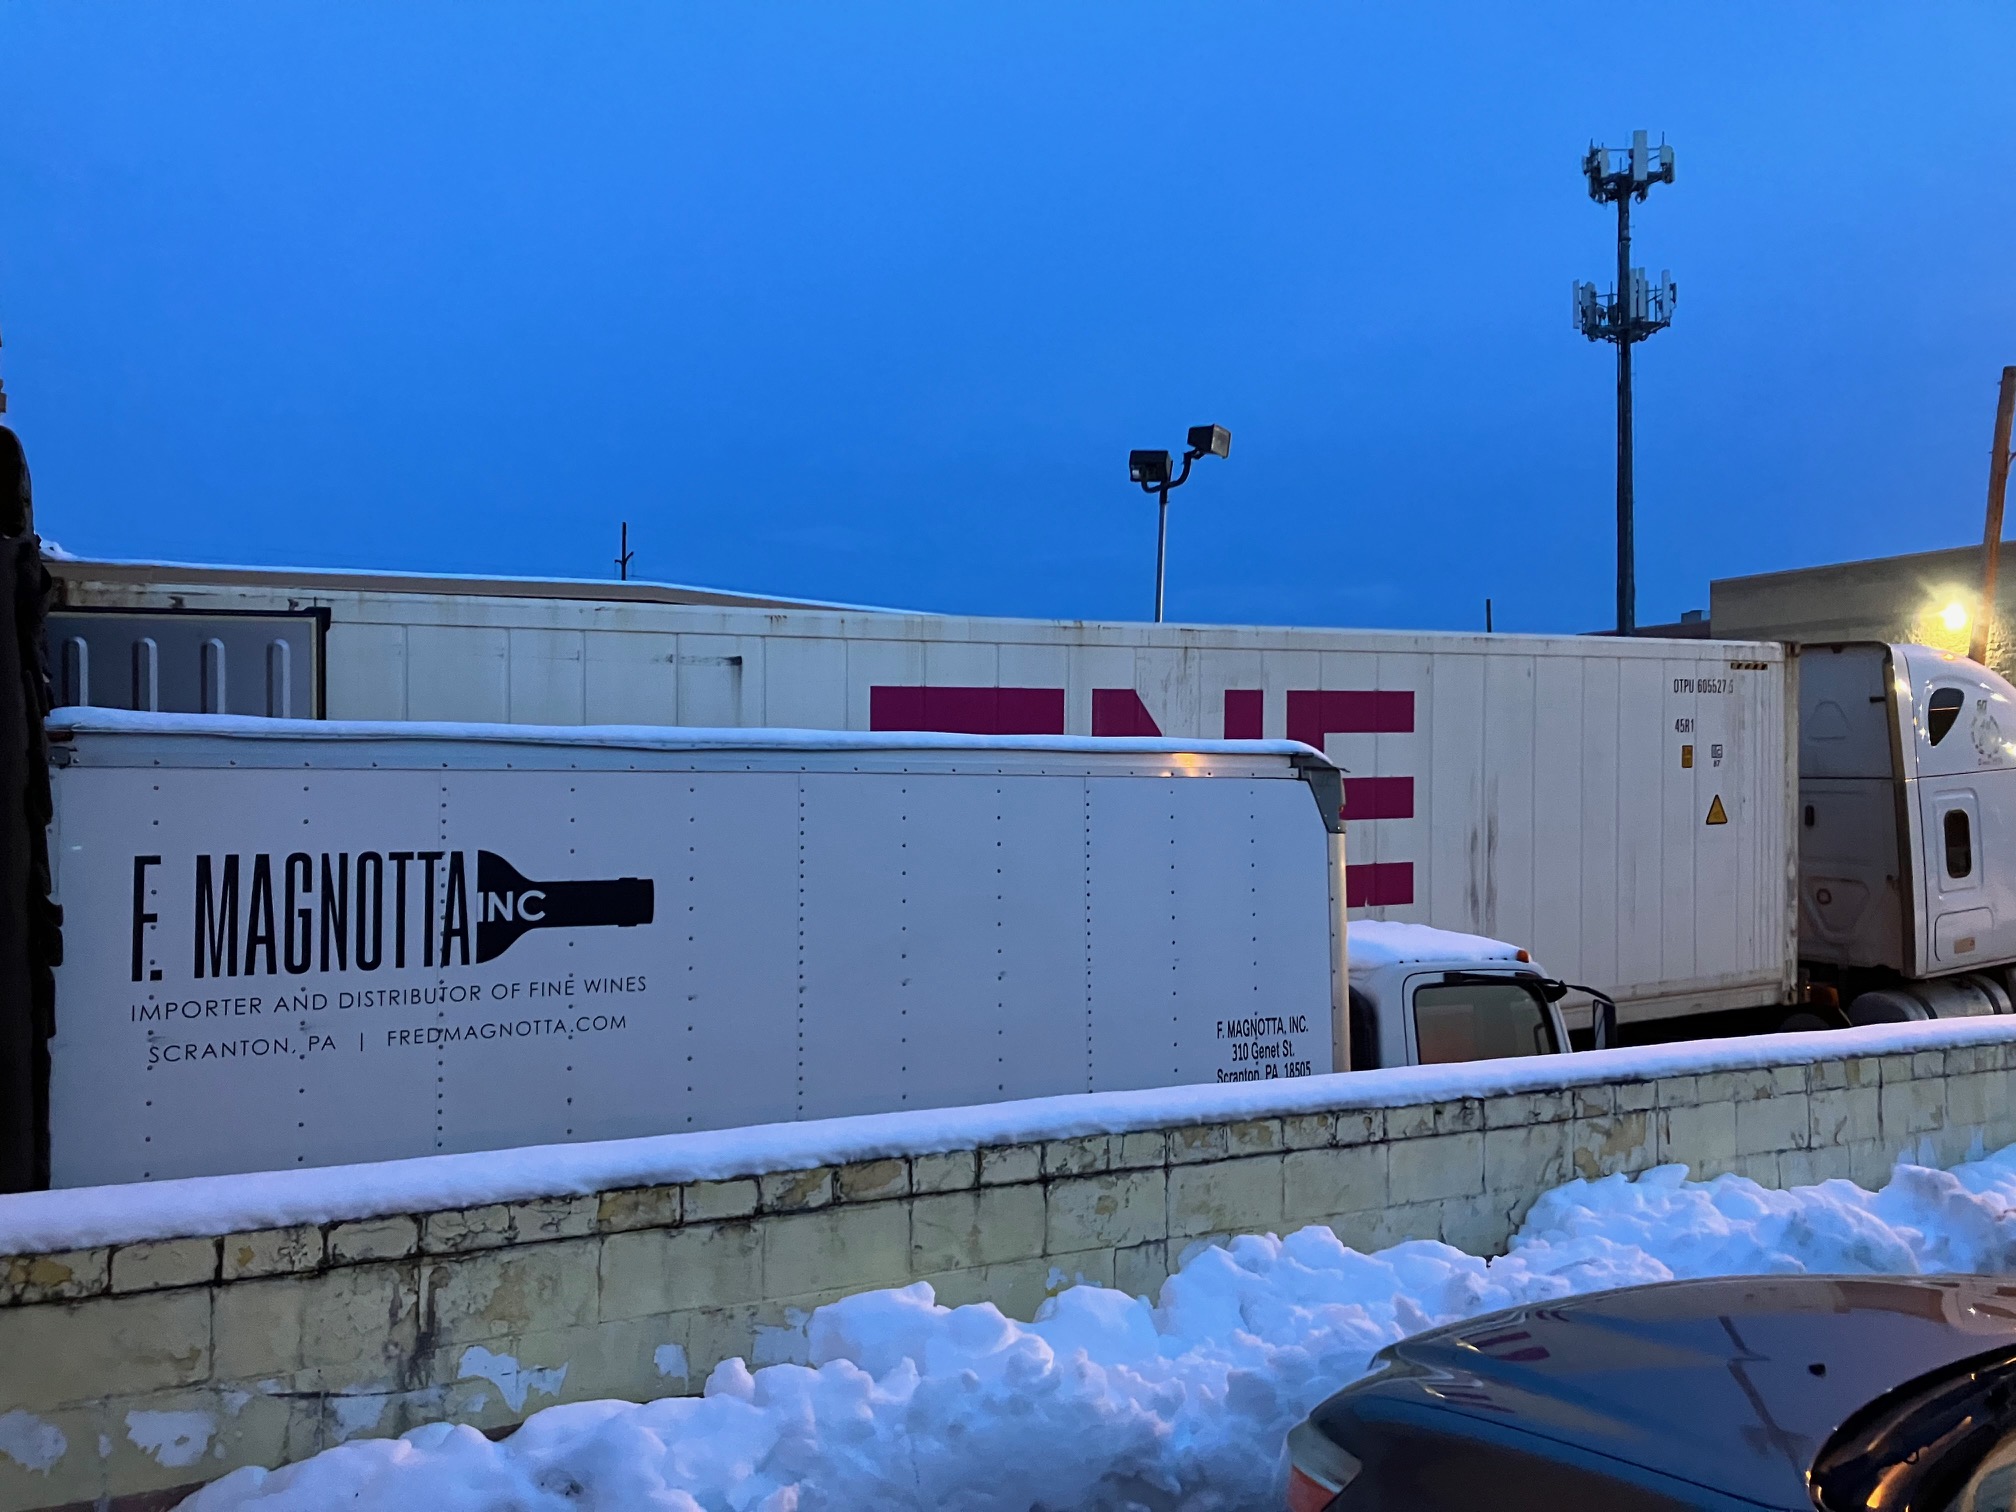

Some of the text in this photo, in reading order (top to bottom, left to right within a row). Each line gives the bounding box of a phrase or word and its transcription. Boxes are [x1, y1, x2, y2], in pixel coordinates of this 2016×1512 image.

[1673, 679, 1695, 693] OTPU
[131, 849, 547, 982] F. MAGNOTTA INC
[131, 976, 647, 1022] IMPORTER AND DISTRIBUTOR OF FINE WINES
[1216, 1015, 1309, 1039] F. MAGNOTTA, INC.
[148, 1037, 297, 1064] SCRANTON,
[308, 1035, 336, 1052] PA
[387, 1015, 627, 1047] FREDMAGNOTTA.COM
[1232, 1040, 1295, 1061] 310 Genet St.
[1284, 1061, 1311, 1078] 18505
